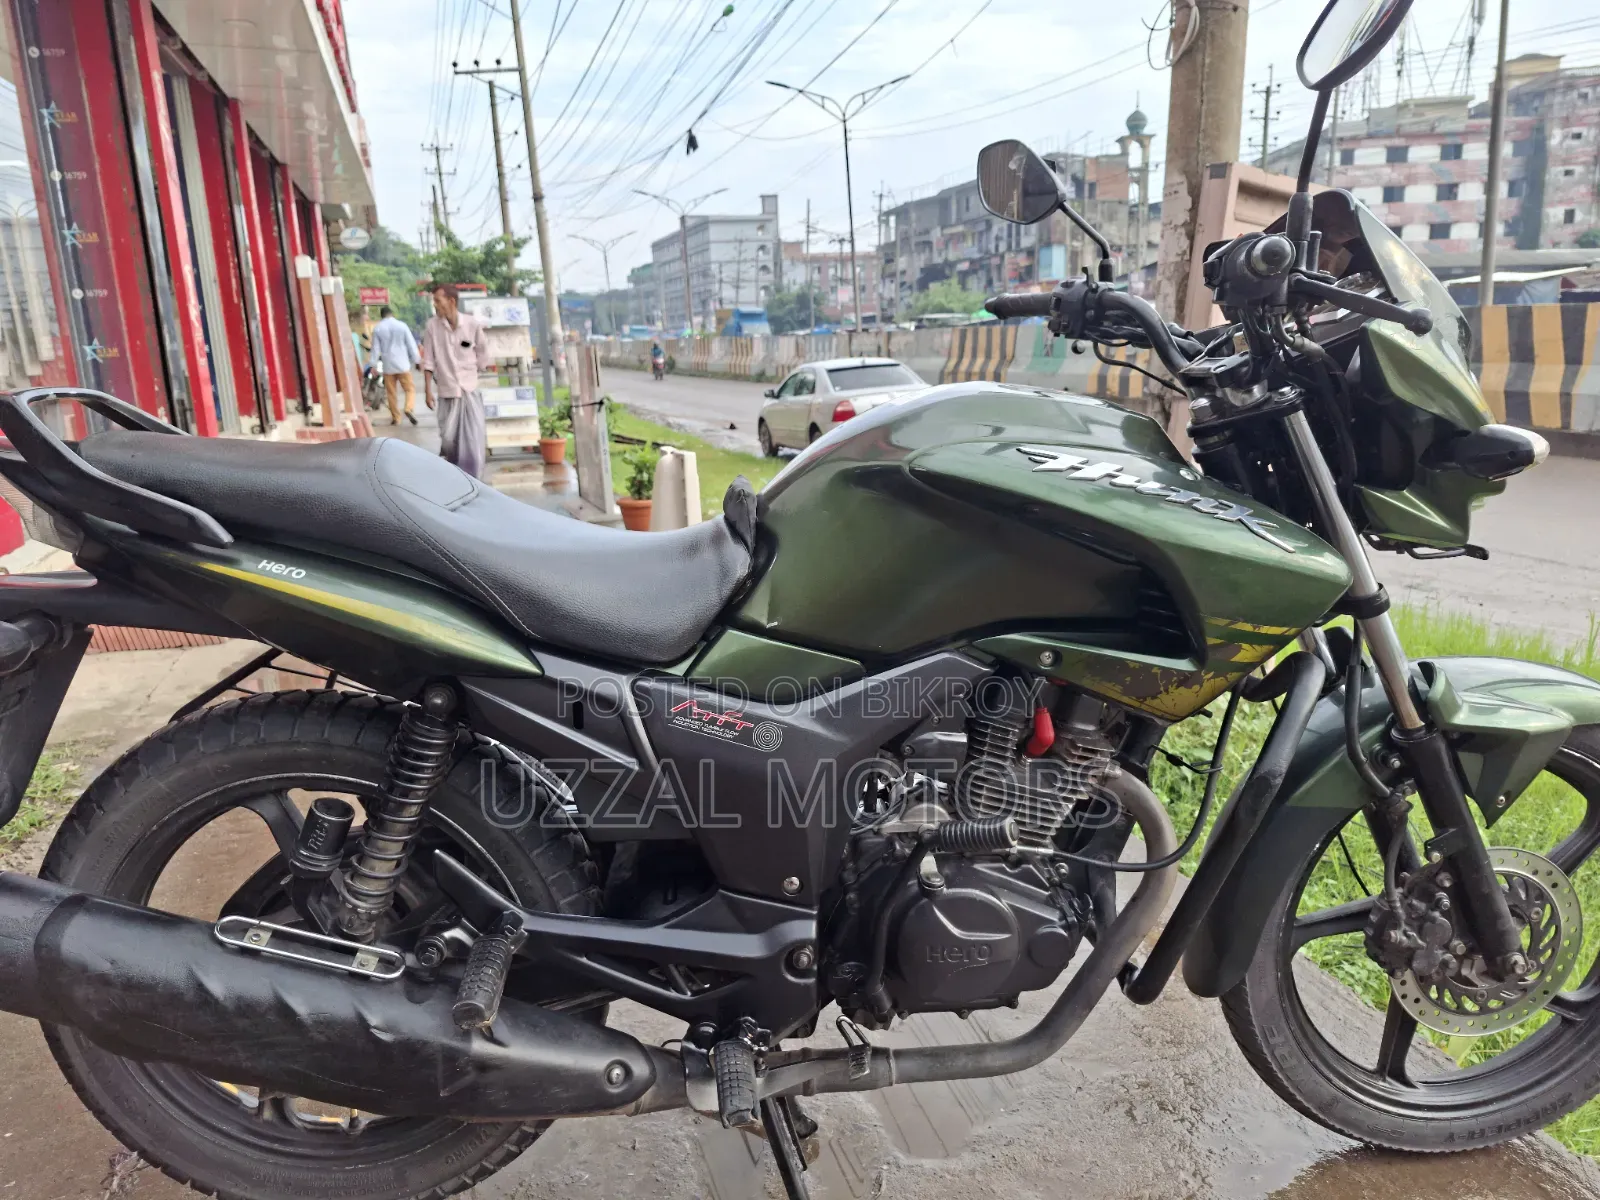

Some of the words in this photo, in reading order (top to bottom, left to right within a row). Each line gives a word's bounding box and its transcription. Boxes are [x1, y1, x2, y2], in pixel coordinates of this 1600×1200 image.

[63, 171, 87, 180] 16759
[85, 288, 108, 298] 16759
[257, 559, 307, 579] Hero
[926, 945, 993, 965] Hero
